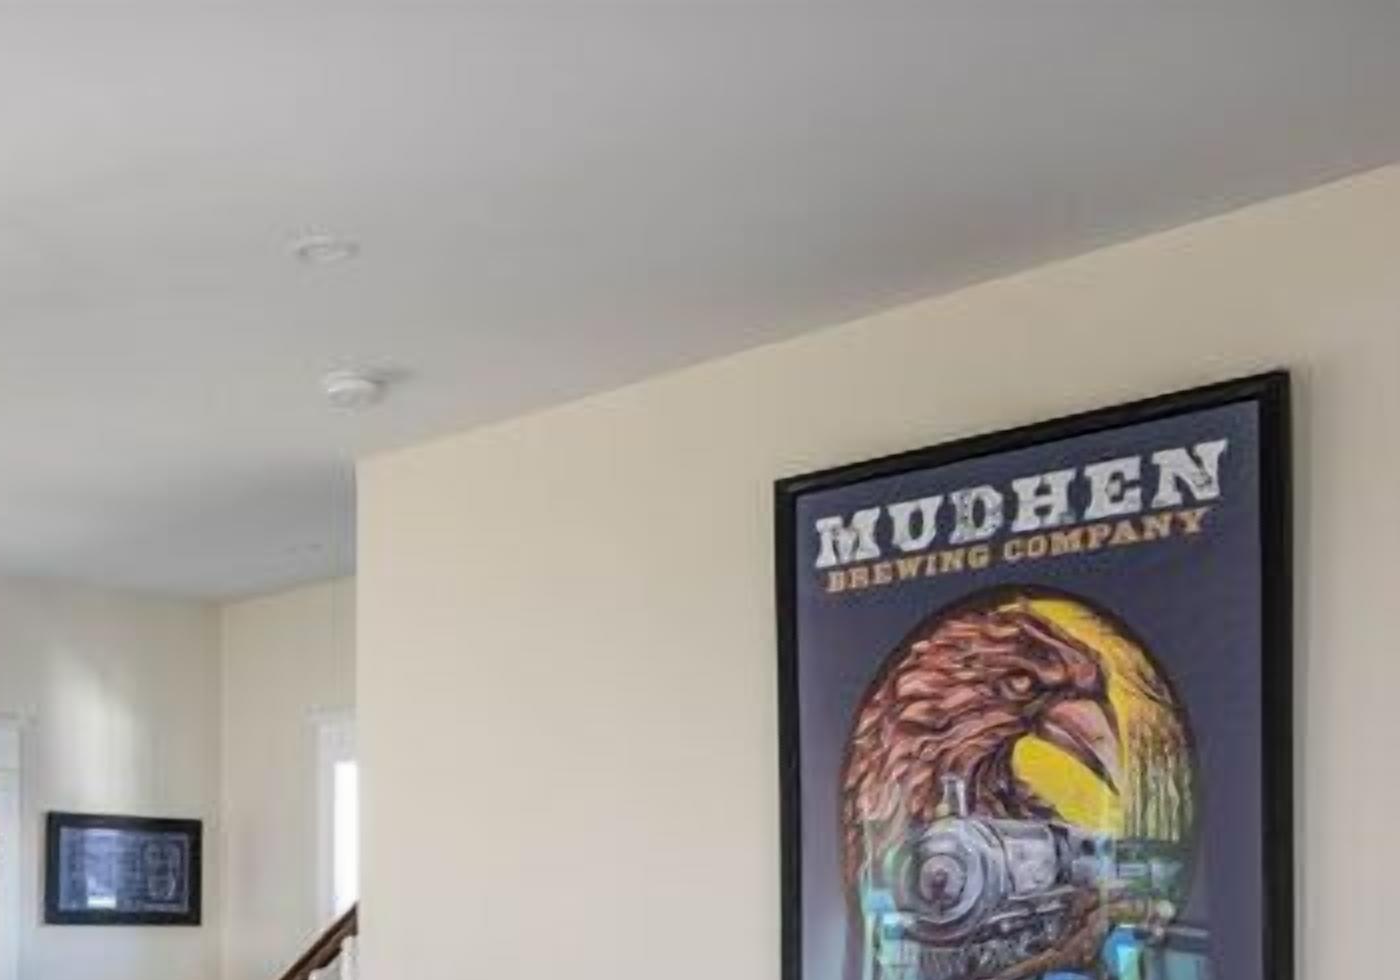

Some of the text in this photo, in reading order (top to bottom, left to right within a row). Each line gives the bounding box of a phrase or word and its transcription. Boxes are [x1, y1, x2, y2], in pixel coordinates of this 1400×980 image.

[815, 439, 1229, 568] MUDHEN
[826, 510, 1207, 593] BREWING COMPANY
